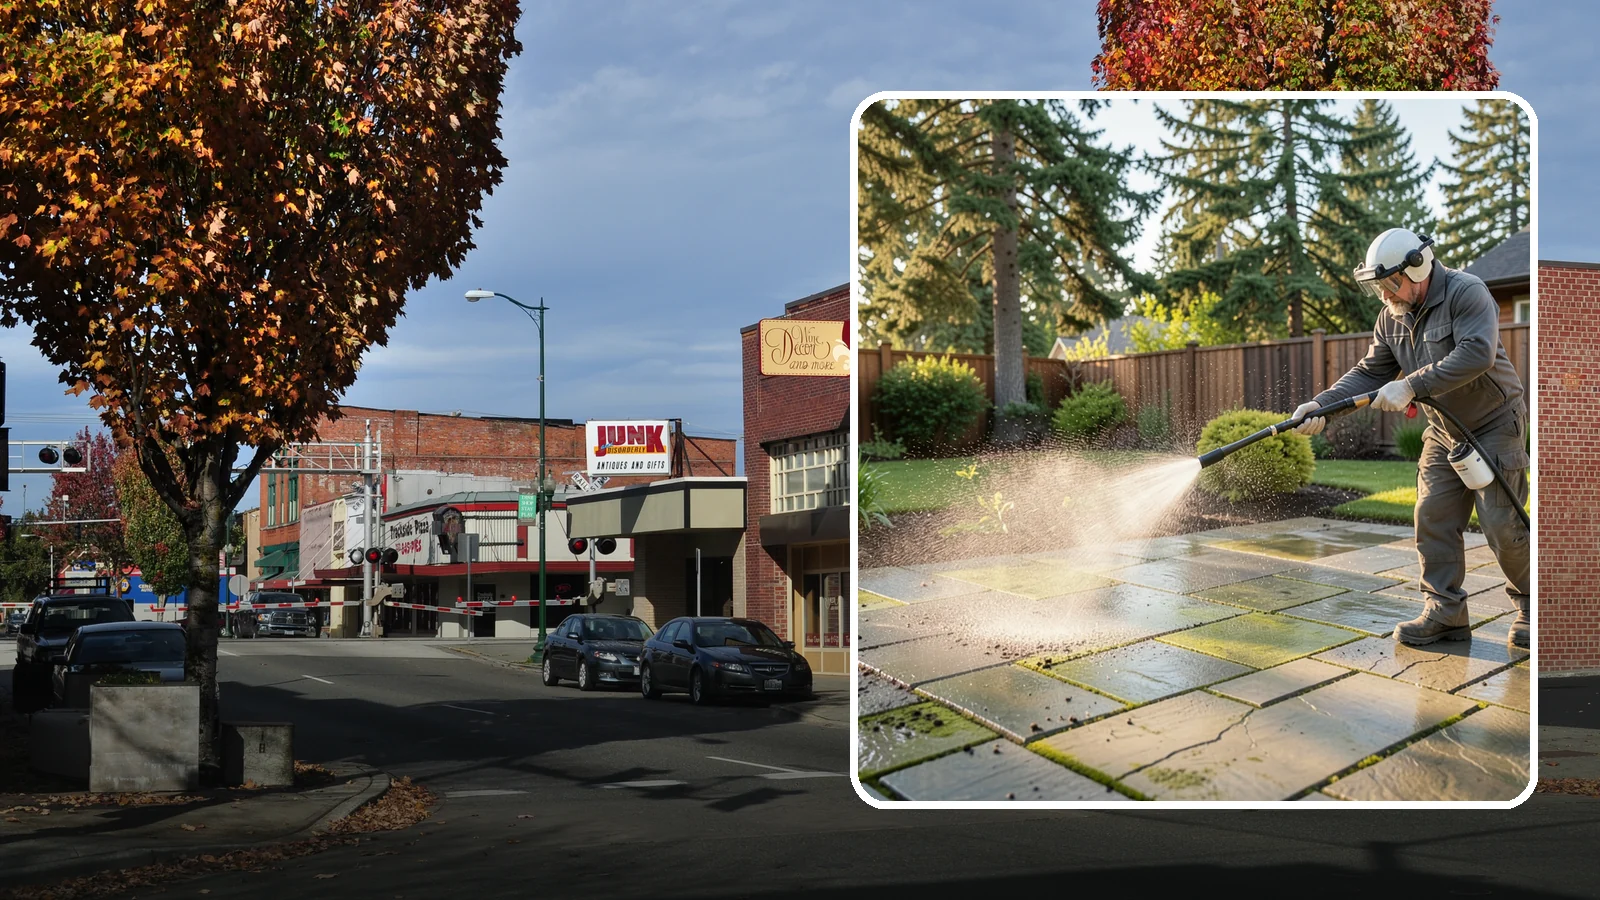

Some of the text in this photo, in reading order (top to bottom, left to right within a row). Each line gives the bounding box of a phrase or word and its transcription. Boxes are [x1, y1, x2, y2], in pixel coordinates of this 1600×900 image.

[595, 425, 665, 457] JUNK
[607, 446, 646, 454] DISORDERLY
[597, 460, 665, 470] ANTIQUES AND GIFTS
[390, 522, 413, 539] Trackside
[414, 519, 429, 534] Pizza
